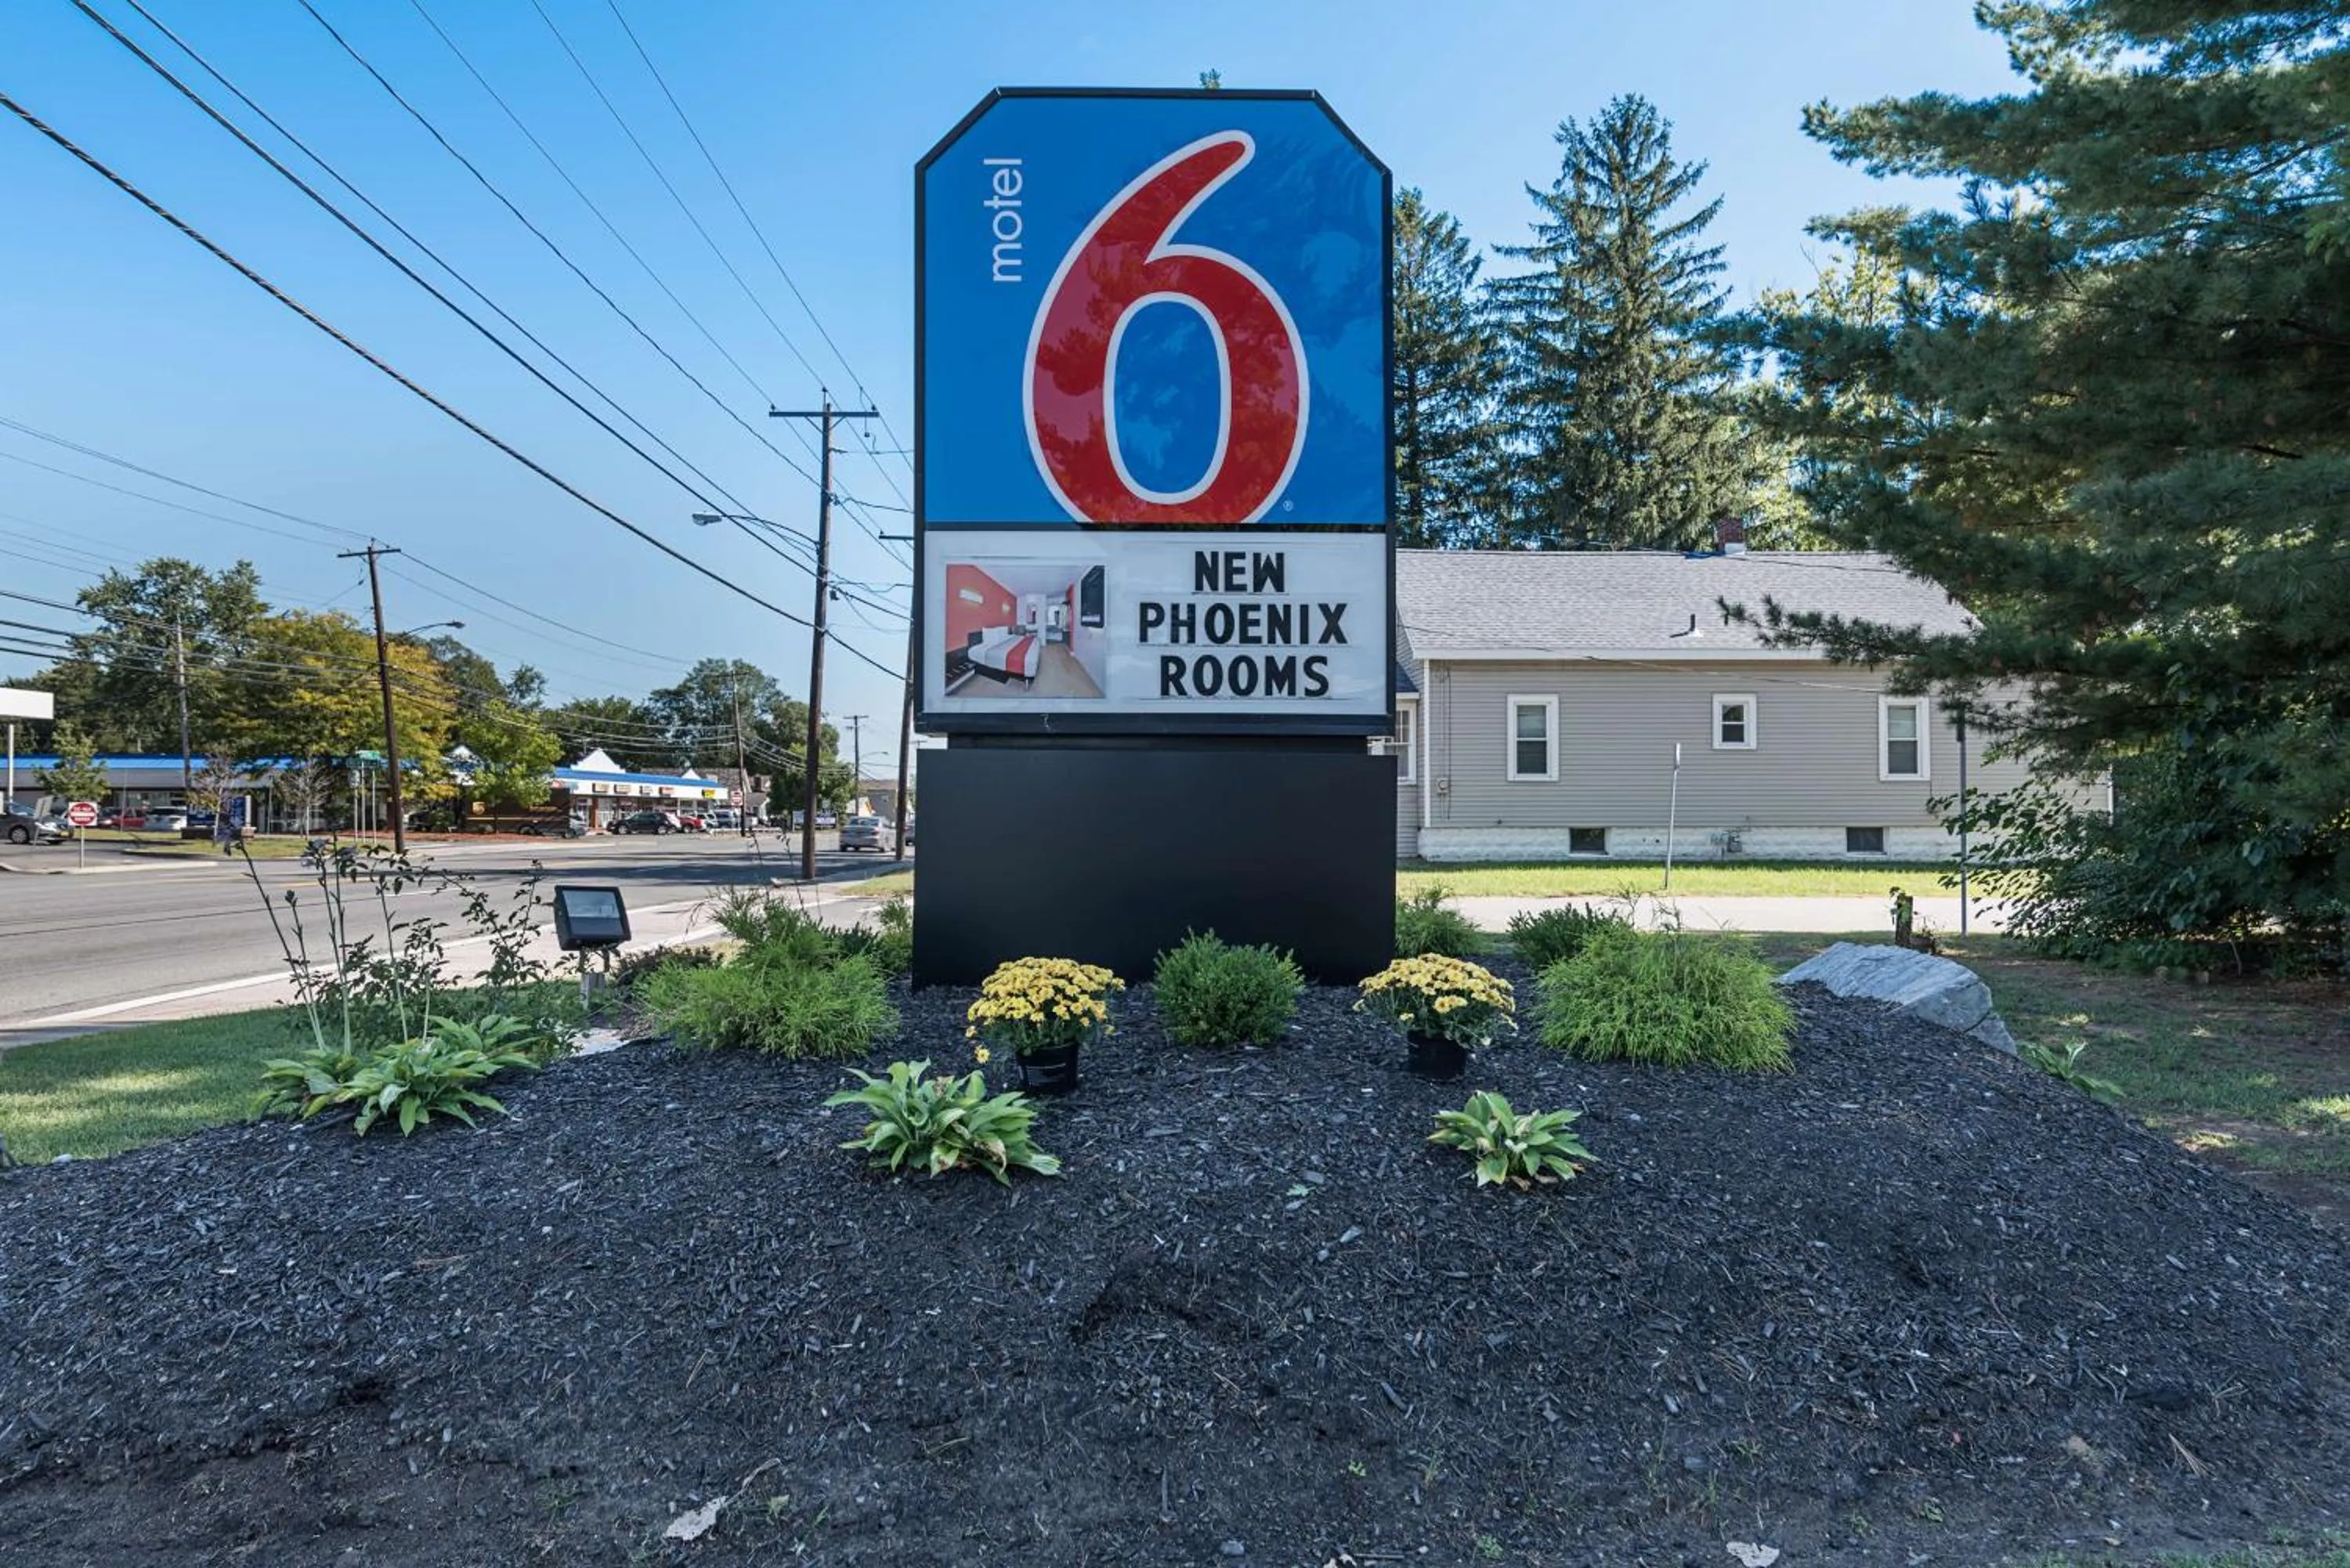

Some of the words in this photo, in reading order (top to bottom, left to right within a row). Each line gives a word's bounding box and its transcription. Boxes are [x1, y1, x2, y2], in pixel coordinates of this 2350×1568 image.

[983, 157, 1022, 283] motel
[1022, 129, 1310, 523] 6
[1195, 551, 1285, 593] NEW
[1139, 602, 1348, 645] PHOENIX
[1160, 654, 1329, 697] ROOMS
